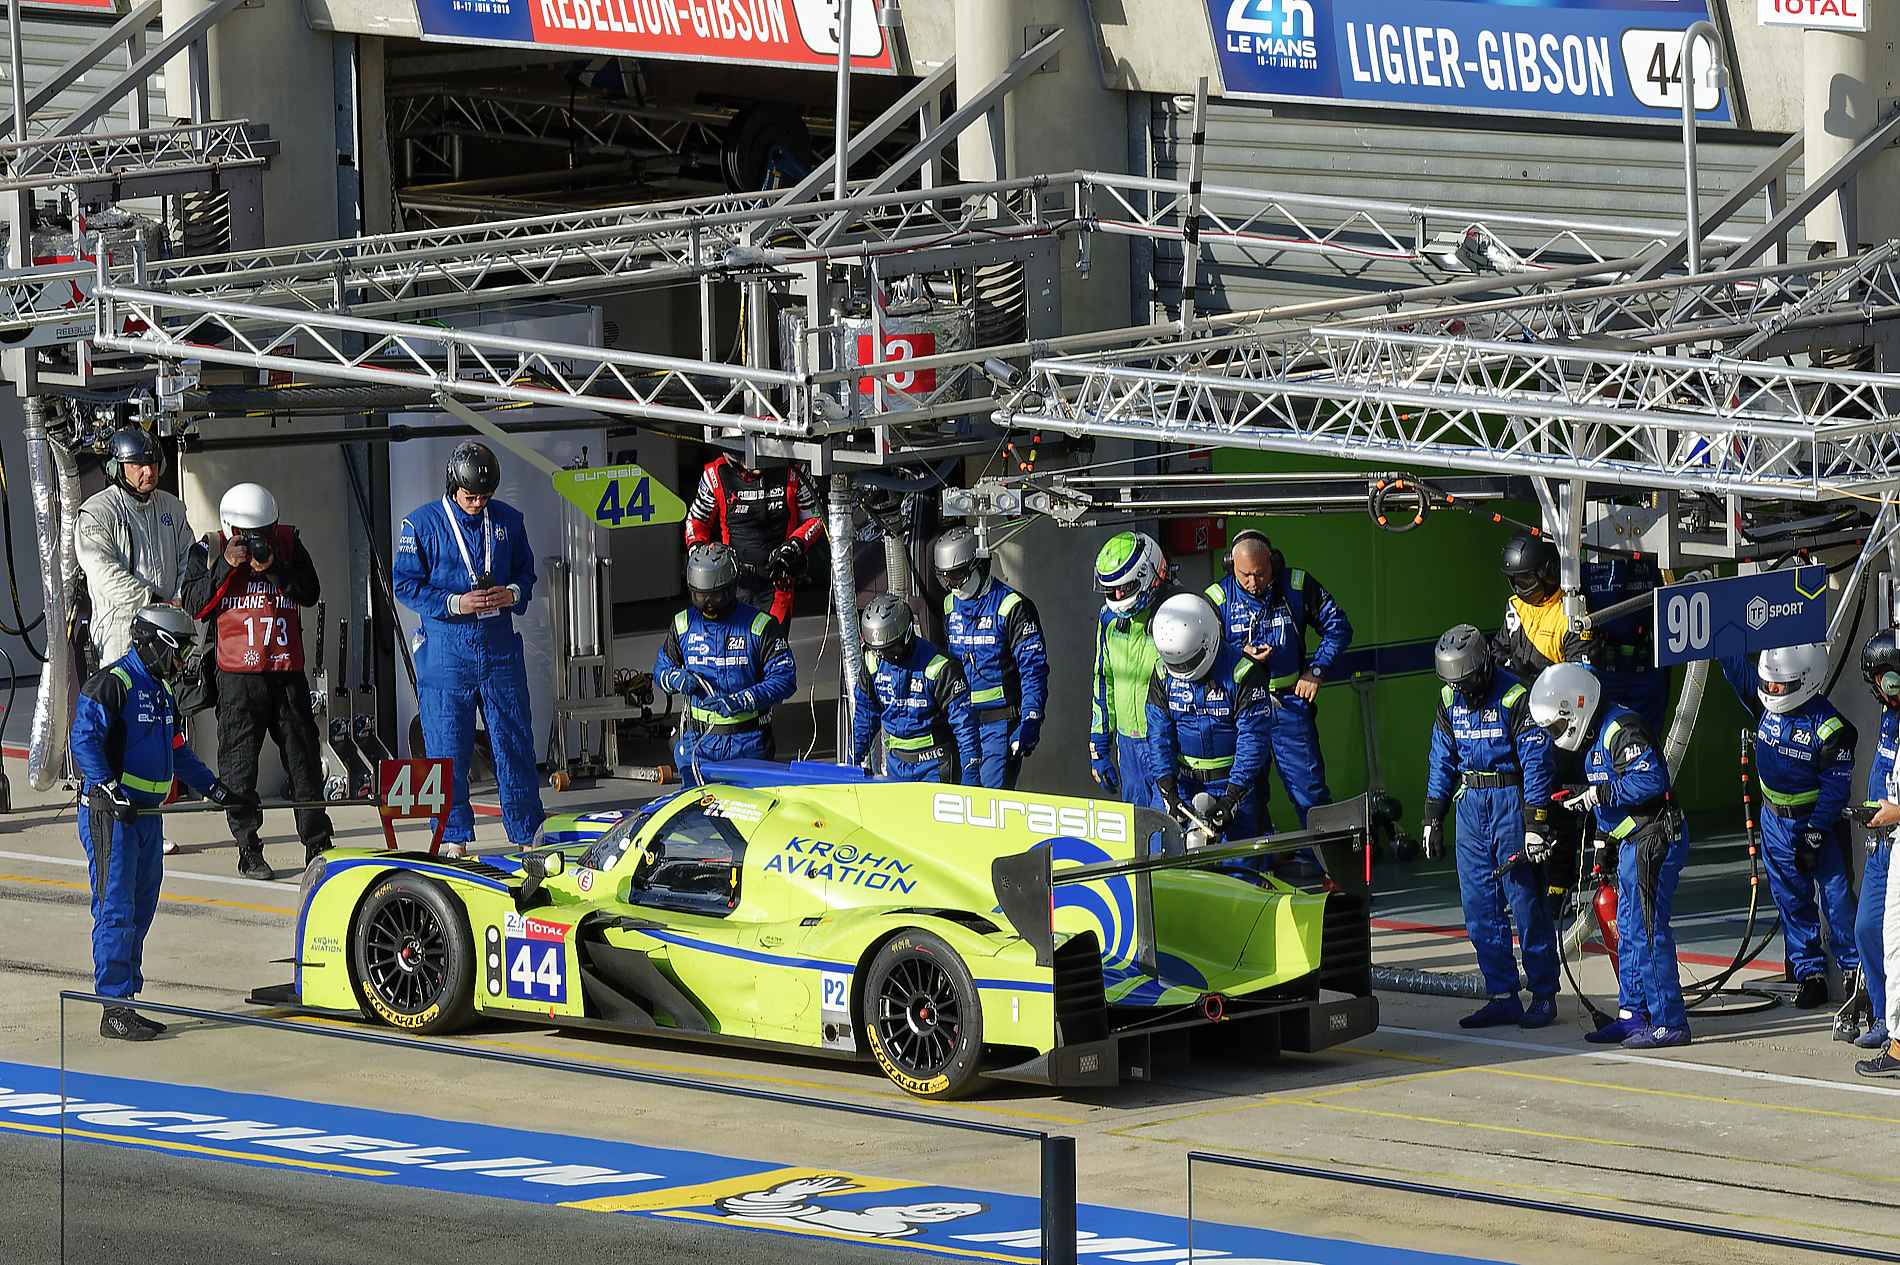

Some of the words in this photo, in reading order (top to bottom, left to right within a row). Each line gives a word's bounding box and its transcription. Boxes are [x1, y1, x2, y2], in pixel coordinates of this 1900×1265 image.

[1226, 33, 1252, 54] LE
[1255, 36, 1317, 58] MANS
[1345, 22, 1614, 98] LIGIER-GIBSON
[885, 339, 915, 391] 3
[574, 467, 641, 482] eurasia
[595, 476, 656, 526] 44
[221, 595, 266, 610] PITLANE
[1667, 591, 1711, 653] 90
[1769, 601, 1804, 618] SPORT
[243, 617, 289, 647] 173
[387, 763, 446, 815] 44
[932, 792, 1127, 843] eurasia
[763, 854, 918, 894] AVIATION
[526, 920, 563, 937] TOTAL
[510, 944, 562, 997] 44
[823, 978, 846, 1007] P2
